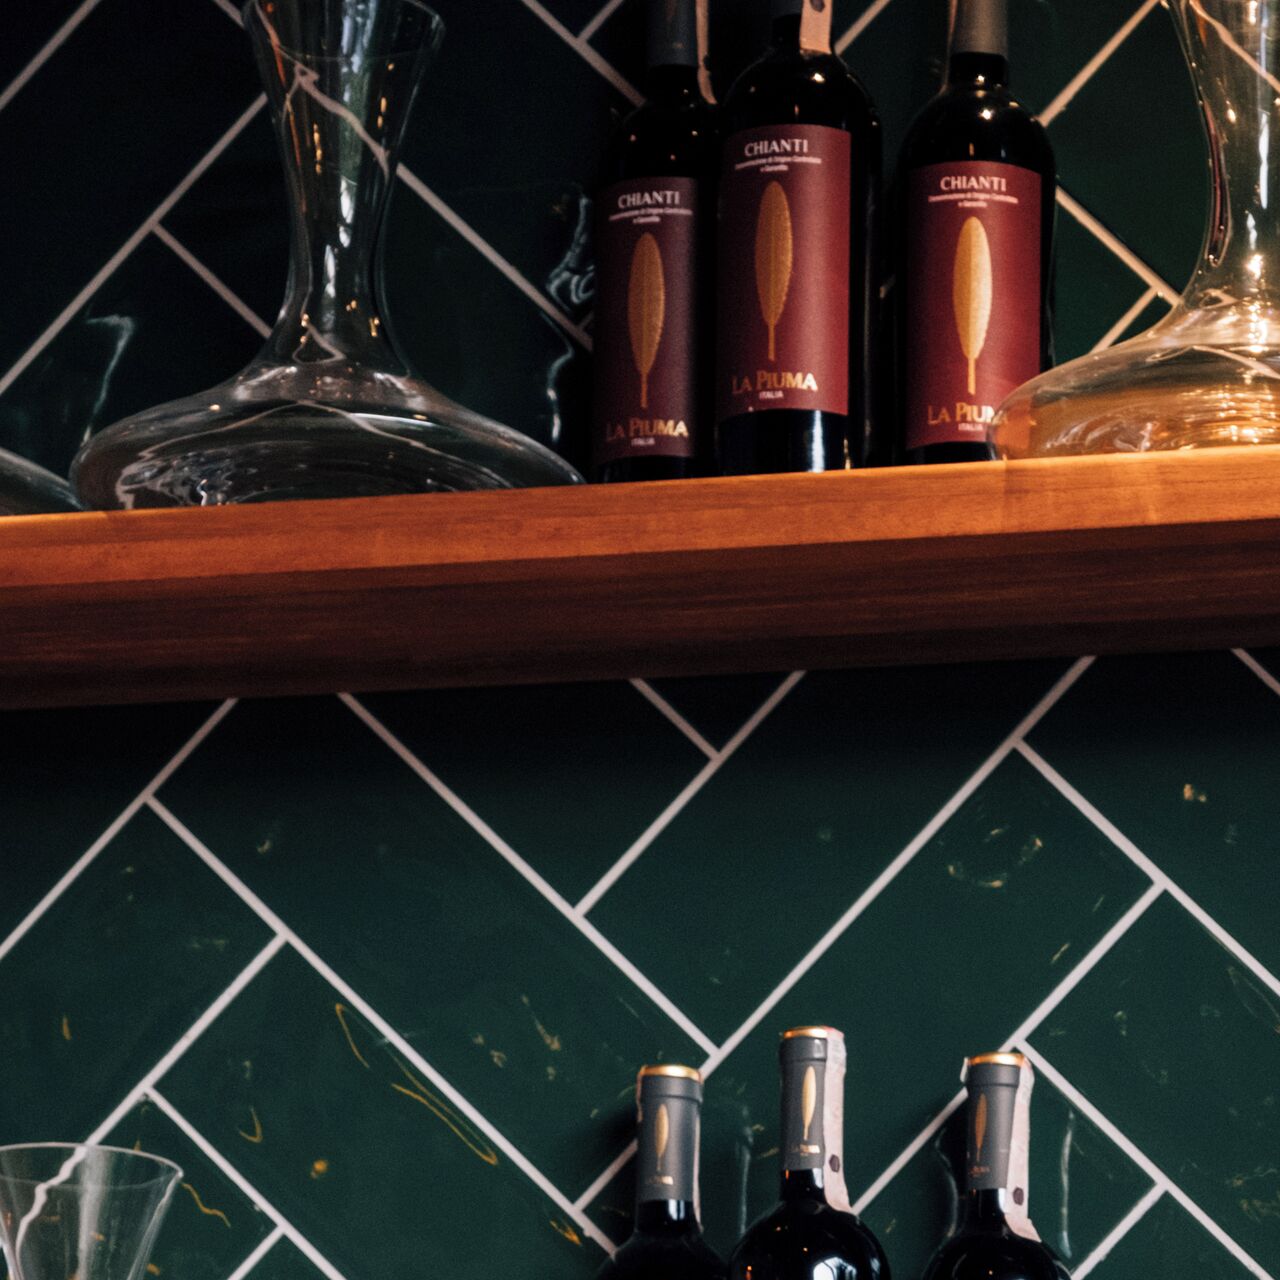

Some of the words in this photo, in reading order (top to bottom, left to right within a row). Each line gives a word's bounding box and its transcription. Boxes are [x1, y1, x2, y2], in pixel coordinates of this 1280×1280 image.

[744, 138, 809, 157] CHIANTI
[940, 175, 1007, 192] CHIANTI
[618, 190, 680, 209] CHIANTI
[733, 375, 752, 394] LA
[756, 370, 818, 391] PIUMA
[928, 404, 951, 425] LA
[629, 416, 689, 438] PIUMA
